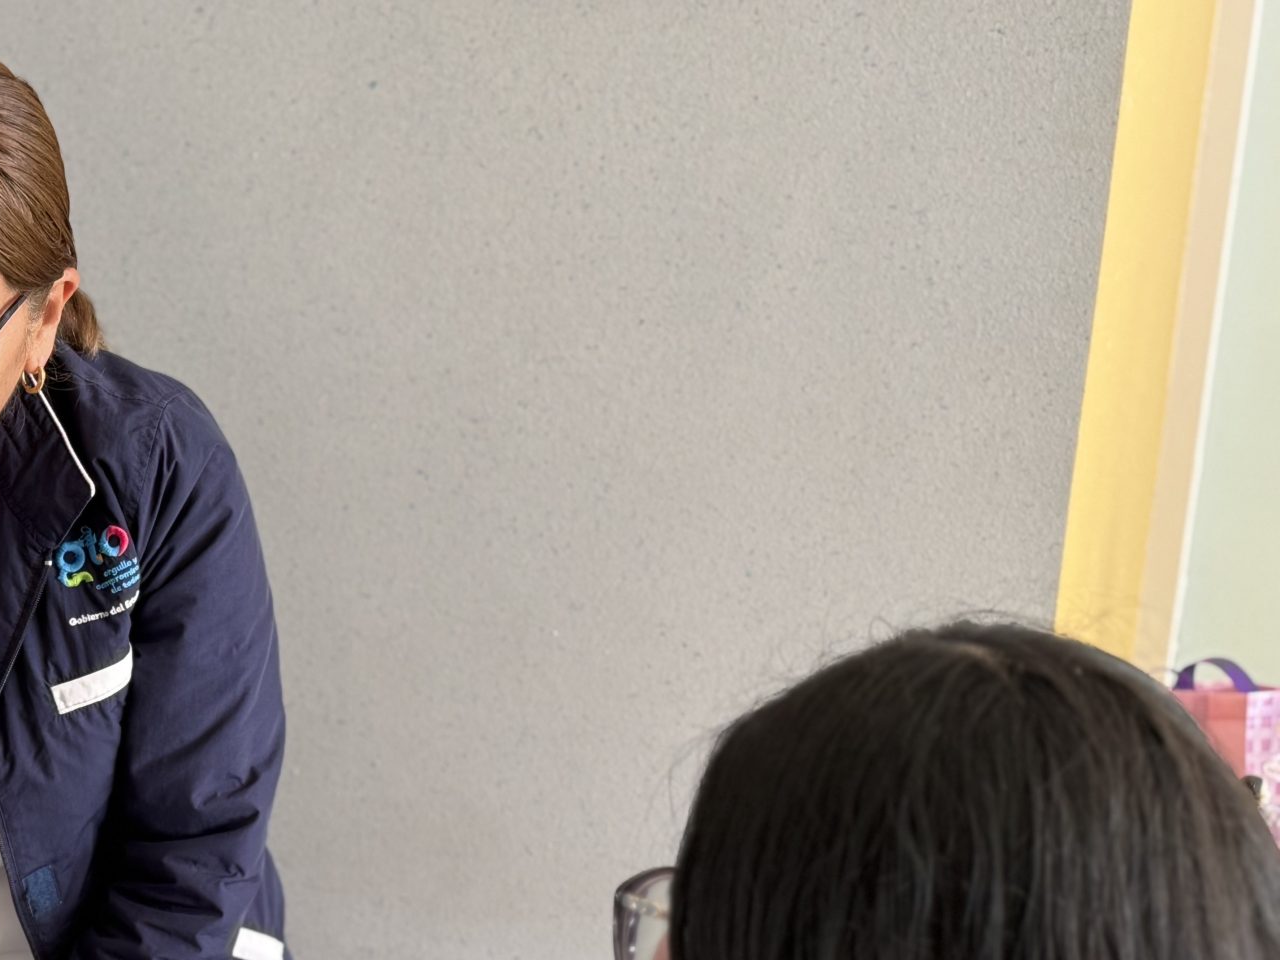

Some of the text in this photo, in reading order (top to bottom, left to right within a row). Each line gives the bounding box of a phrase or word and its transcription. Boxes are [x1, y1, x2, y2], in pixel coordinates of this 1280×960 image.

[104, 559, 132, 577] orgullo
[69, 611, 109, 626] Gobierno
[110, 603, 125, 616] del
